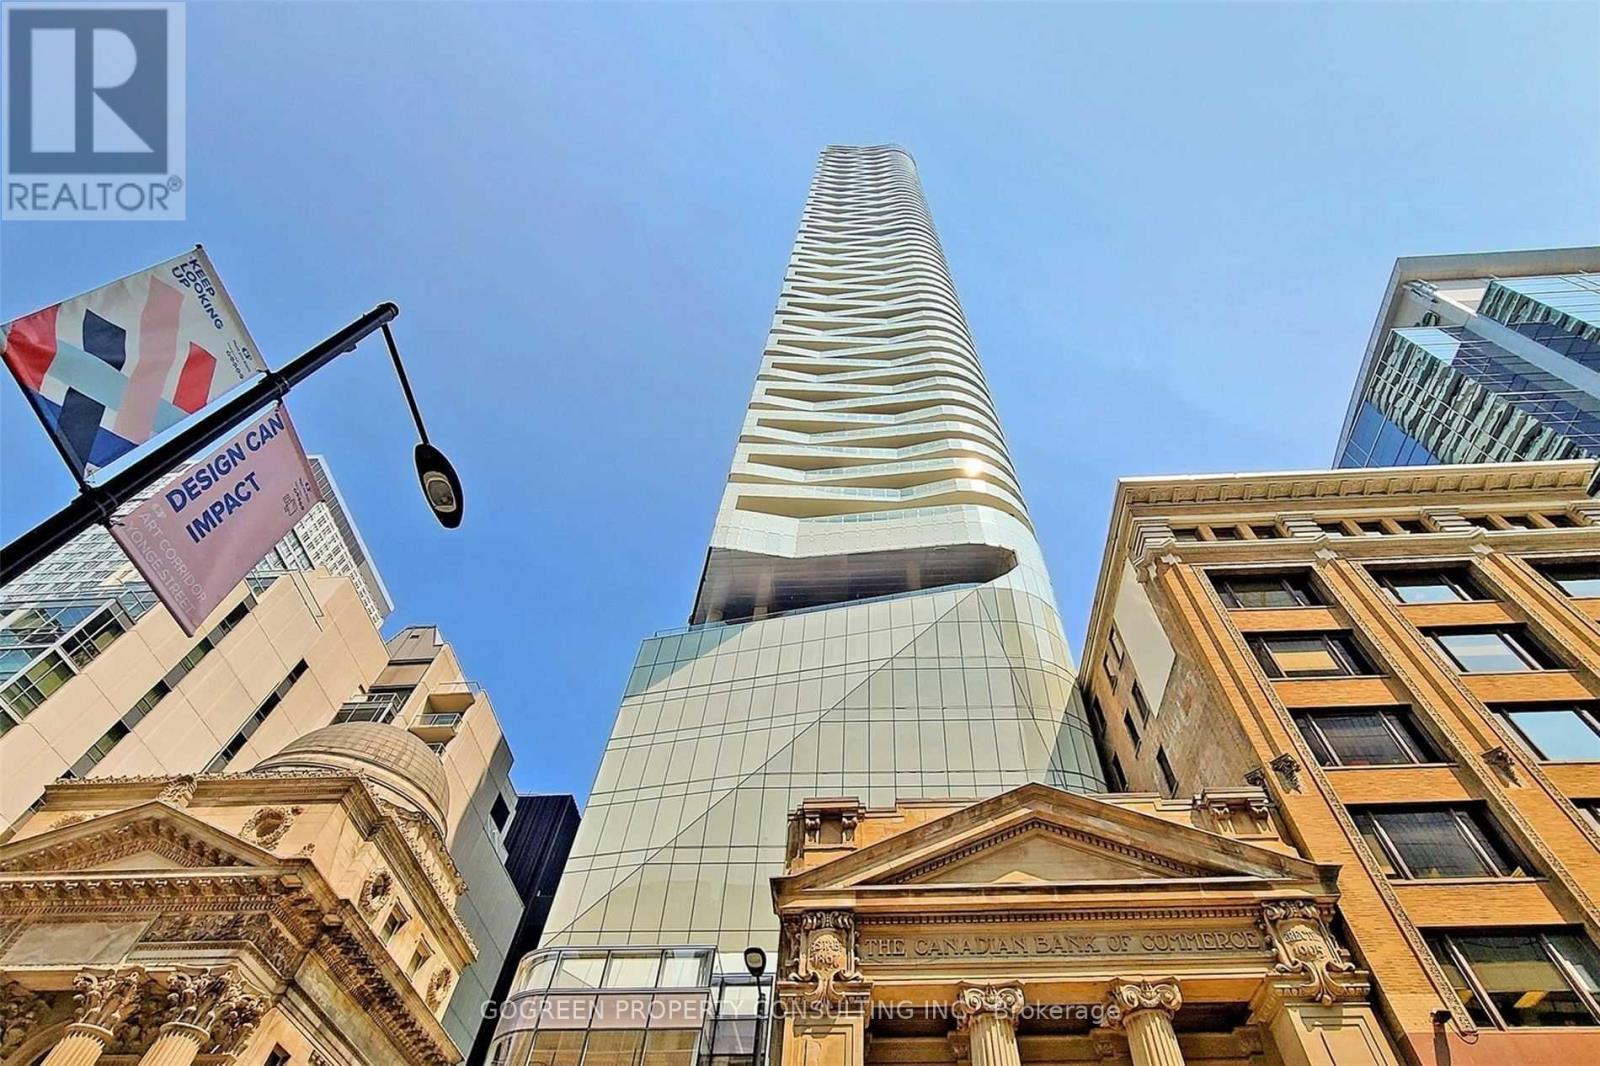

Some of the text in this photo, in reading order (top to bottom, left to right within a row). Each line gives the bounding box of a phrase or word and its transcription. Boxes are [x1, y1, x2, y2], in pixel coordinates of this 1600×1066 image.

[172, 266, 191, 289] UP
[180, 262, 224, 330] LOOKING
[189, 259, 216, 297] KEEP
[165, 443, 246, 514] DESIGN
[245, 413, 285, 452] CAN
[185, 471, 261, 544] IMPACT
[126, 520, 163, 570] YONGE
[160, 569, 197, 614] STREET
[140, 512, 162, 537] ART
[160, 539, 207, 601] CORRIDOR
[865, 938, 906, 957] THE
[914, 937, 1027, 956] CANADIAN
[1034, 935, 1098, 954] BANK
[1107, 935, 1132, 952] OF
[1140, 930, 1261, 952] COMMERCE
